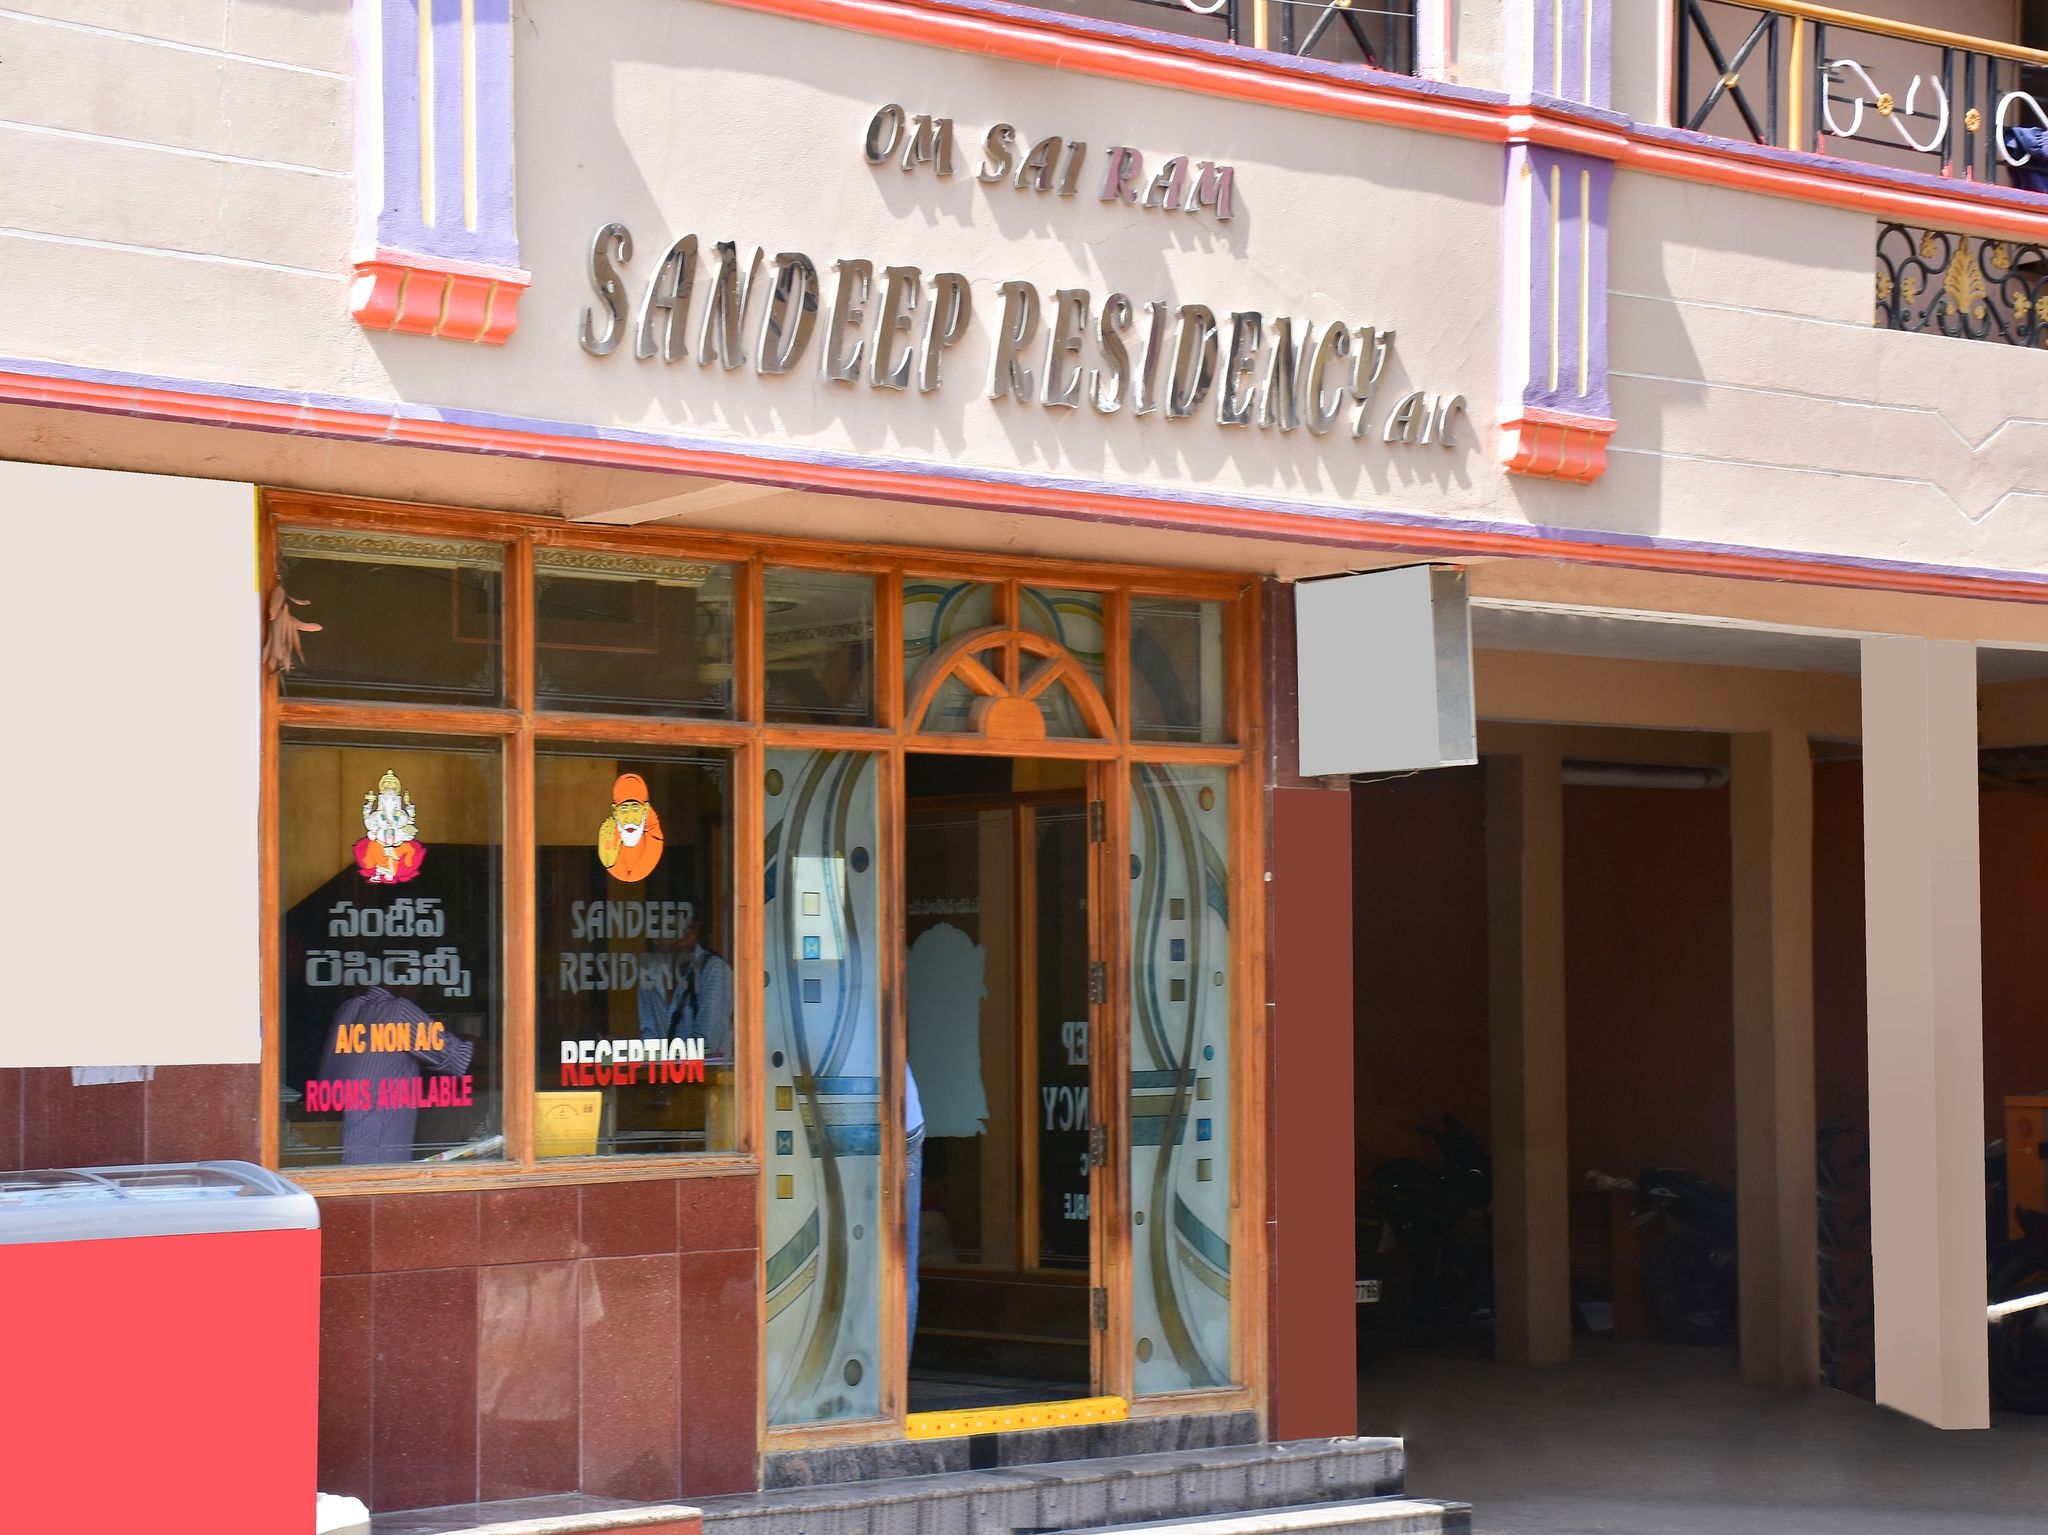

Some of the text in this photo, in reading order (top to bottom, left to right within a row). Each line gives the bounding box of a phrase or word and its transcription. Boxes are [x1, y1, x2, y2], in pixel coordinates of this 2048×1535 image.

[864, 102, 1236, 222] OM SAI RAM
[578, 221, 974, 394] SANDEEP
[989, 279, 1396, 439] RESIDENCY
[570, 900, 694, 942] SANDEEP
[334, 1021, 446, 1054] A/C NON A/C
[560, 1037, 705, 1087] RECEPTION
[305, 1074, 474, 1113] ROOMS AVAILABLE
